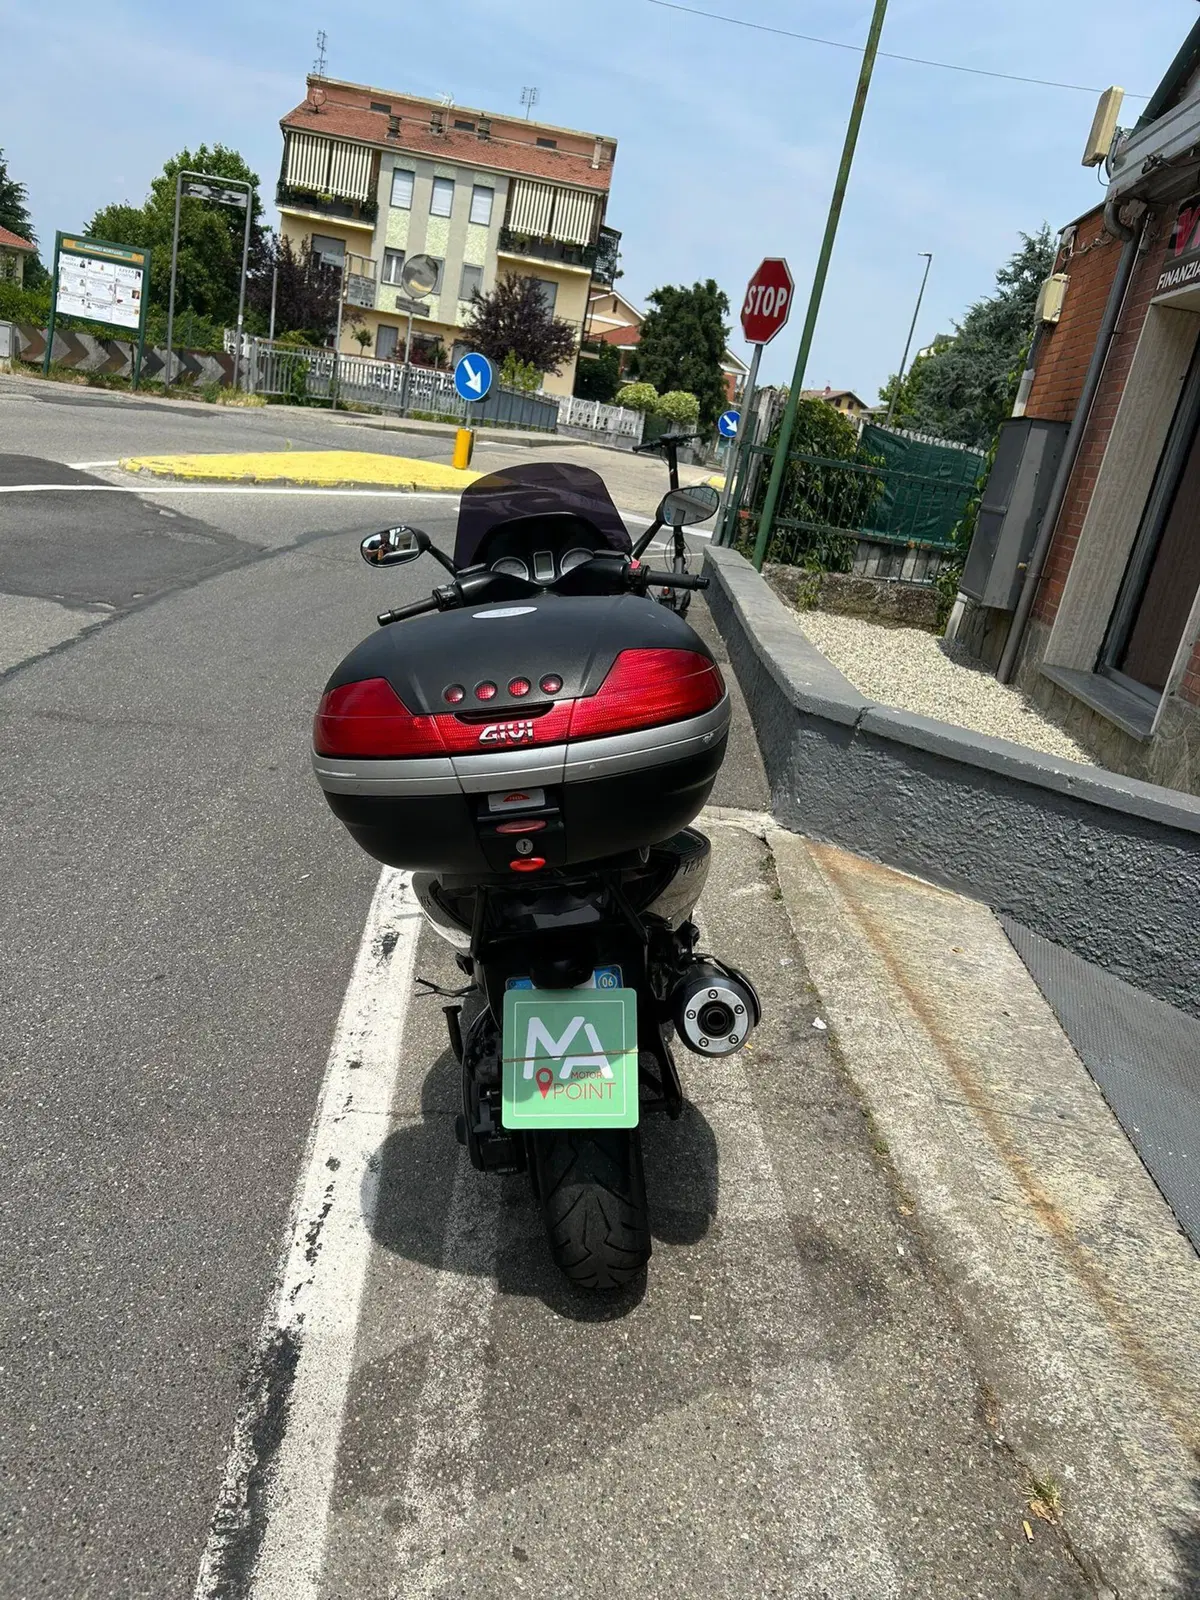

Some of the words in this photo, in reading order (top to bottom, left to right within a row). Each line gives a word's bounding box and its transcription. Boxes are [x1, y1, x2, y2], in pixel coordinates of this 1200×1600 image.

[744, 285, 788, 318] STOP
[479, 721, 534, 744] GIVI
[601, 976, 614, 988] 06
[523, 1016, 614, 1079] MA
[571, 1071, 603, 1079] MOTOR
[553, 1082, 616, 1100] POINT
